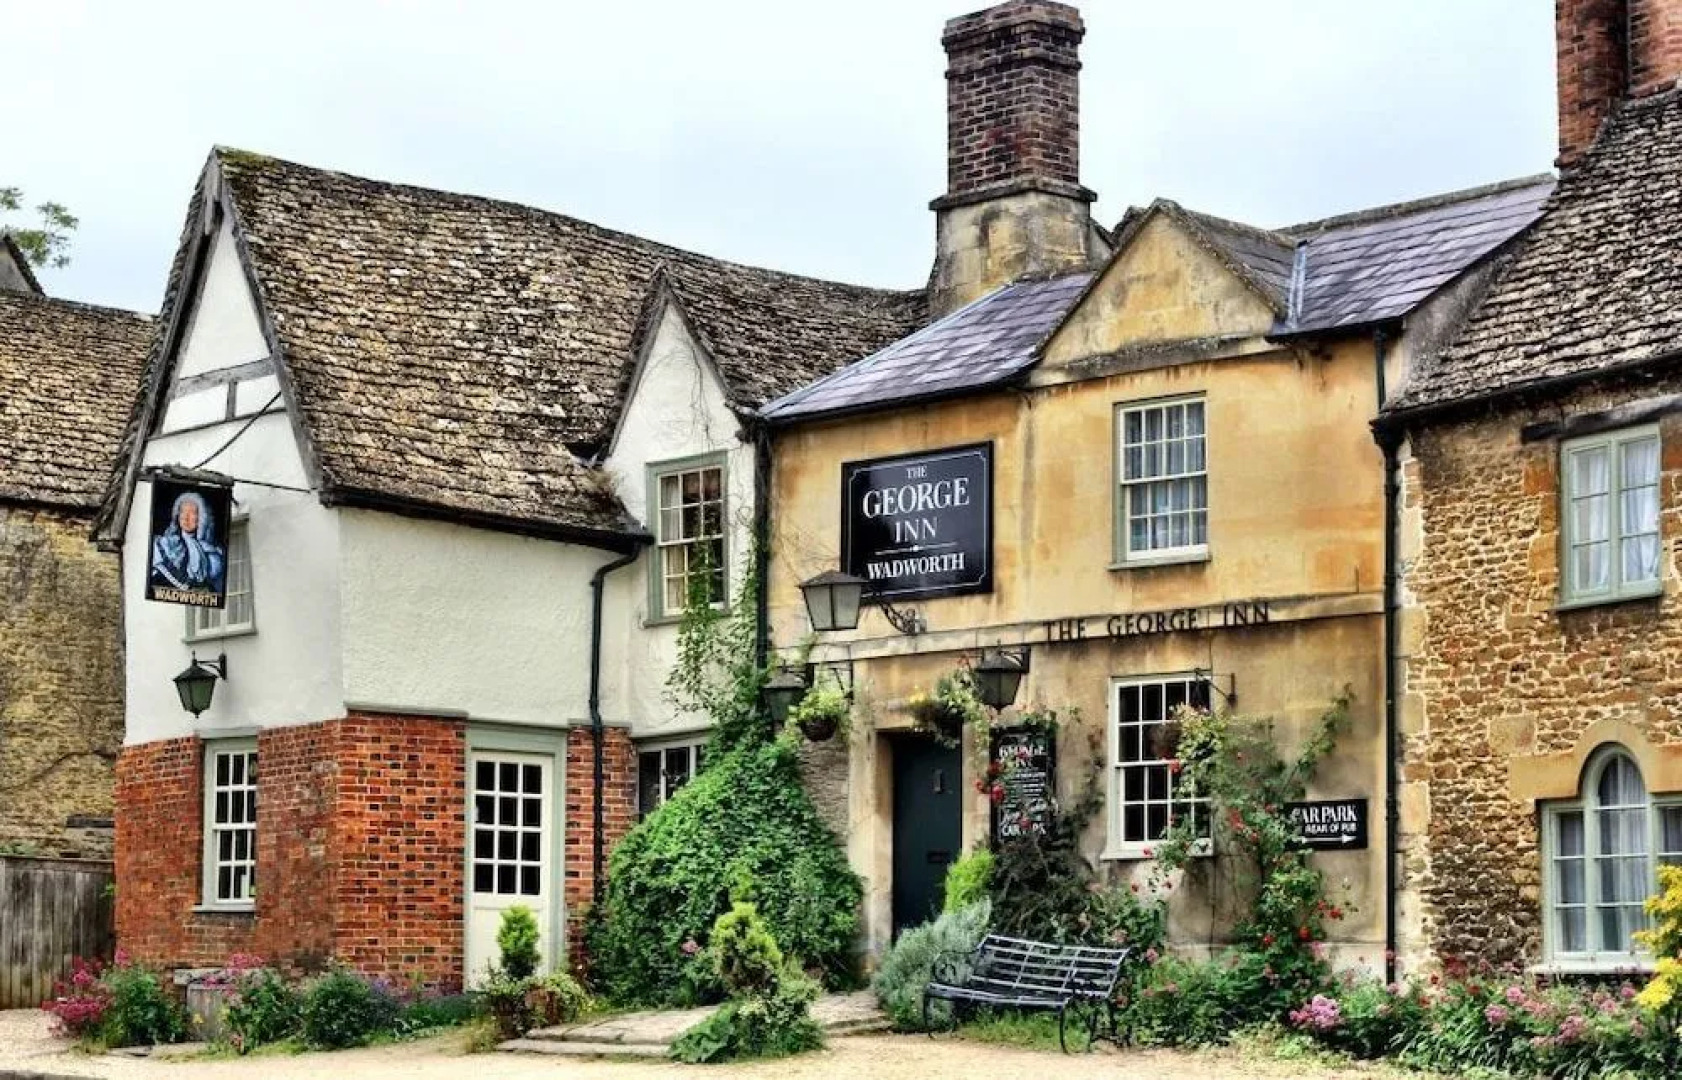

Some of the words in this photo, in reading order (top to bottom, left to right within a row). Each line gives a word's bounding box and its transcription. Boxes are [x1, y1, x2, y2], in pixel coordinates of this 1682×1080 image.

[906, 465, 927, 478] THE
[862, 477, 970, 518] GEORGE
[895, 517, 938, 543] INN
[867, 552, 965, 579] WADWORTH
[154, 588, 218, 606] WADWORTH
[1043, 619, 1087, 643] THE
[1107, 609, 1198, 638] GEORGE
[1224, 602, 1268, 626] INN
[1321, 804, 1358, 823] PARK
[1329, 822, 1339, 833] OF
